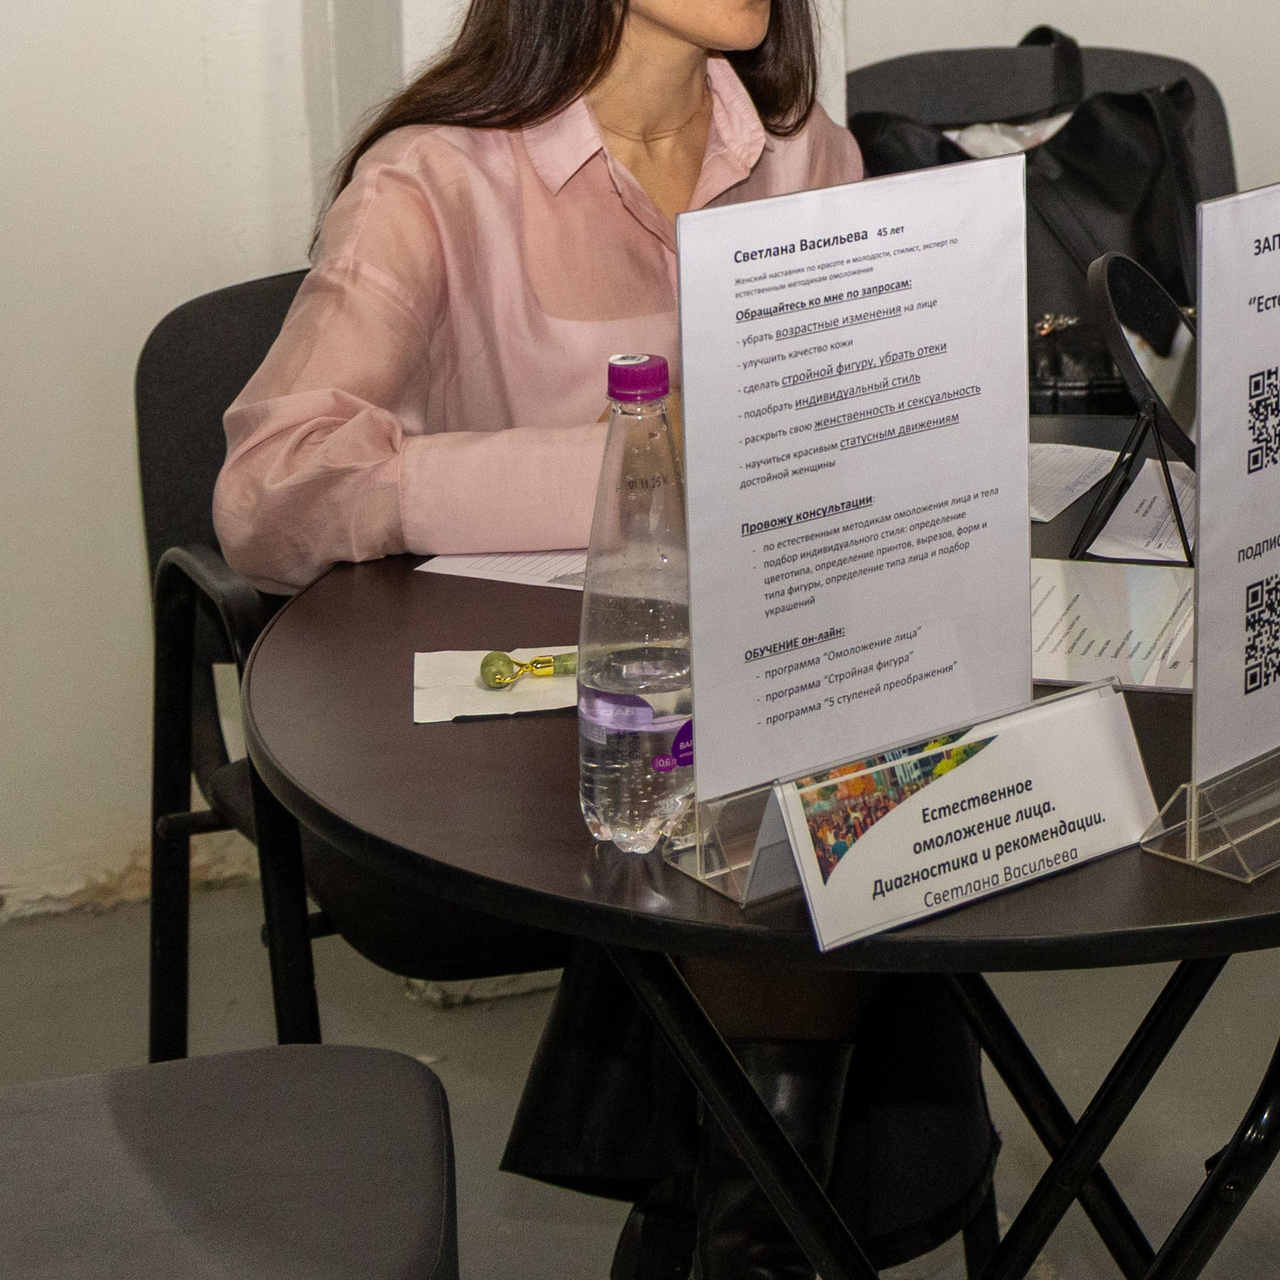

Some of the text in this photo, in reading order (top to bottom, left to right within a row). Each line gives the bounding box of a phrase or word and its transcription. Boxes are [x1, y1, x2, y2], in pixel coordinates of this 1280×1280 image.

[733, 225, 904, 263] Светлана Васильева 45 лет
[734, 279, 912, 320] Обращайтесь ко мне по запросам:
[741, 298, 938, 347] убрать возрастные изменения на лице
[741, 339, 854, 370] улучшить качество кожи
[742, 342, 947, 394] сделать стройной фигуру, убрать отеки
[743, 373, 921, 418] подобрать индивидуальный стиль
[743, 385, 981, 446] раскрыть свою женственность и сексуальность
[744, 413, 960, 469] научиться красивым статусным движениям
[739, 460, 836, 490] достойной женщины
[740, 495, 875, 534] Провожу консультации:
[762, 487, 999, 552] по естественным методикам омоложения лица и тела
[762, 511, 966, 568] подбор индивидуального стиля: определение
[763, 566, 813, 585] цветотипа,
[814, 550, 874, 571] определение
[875, 540, 914, 556] принтов,
[915, 530, 955, 545] вырезов,
[955, 523, 980, 536] форм
[763, 541, 970, 600] типа фигуры, определение типа лица и подбор
[763, 595, 816, 618] украшений
[744, 627, 845, 660] ОБУЧЕНИЕ он-лайн:
[764, 656, 821, 679] программа
[764, 679, 821, 702] программа
[765, 702, 822, 725] программа
[836, 682, 881, 704] ступеней
[921, 779, 1033, 823] Естественное
[912, 801, 1056, 854] омоложение лица.
[871, 813, 1106, 899] Диагностика и рекомендации.
[922, 847, 1078, 907] Светлана Васильева
